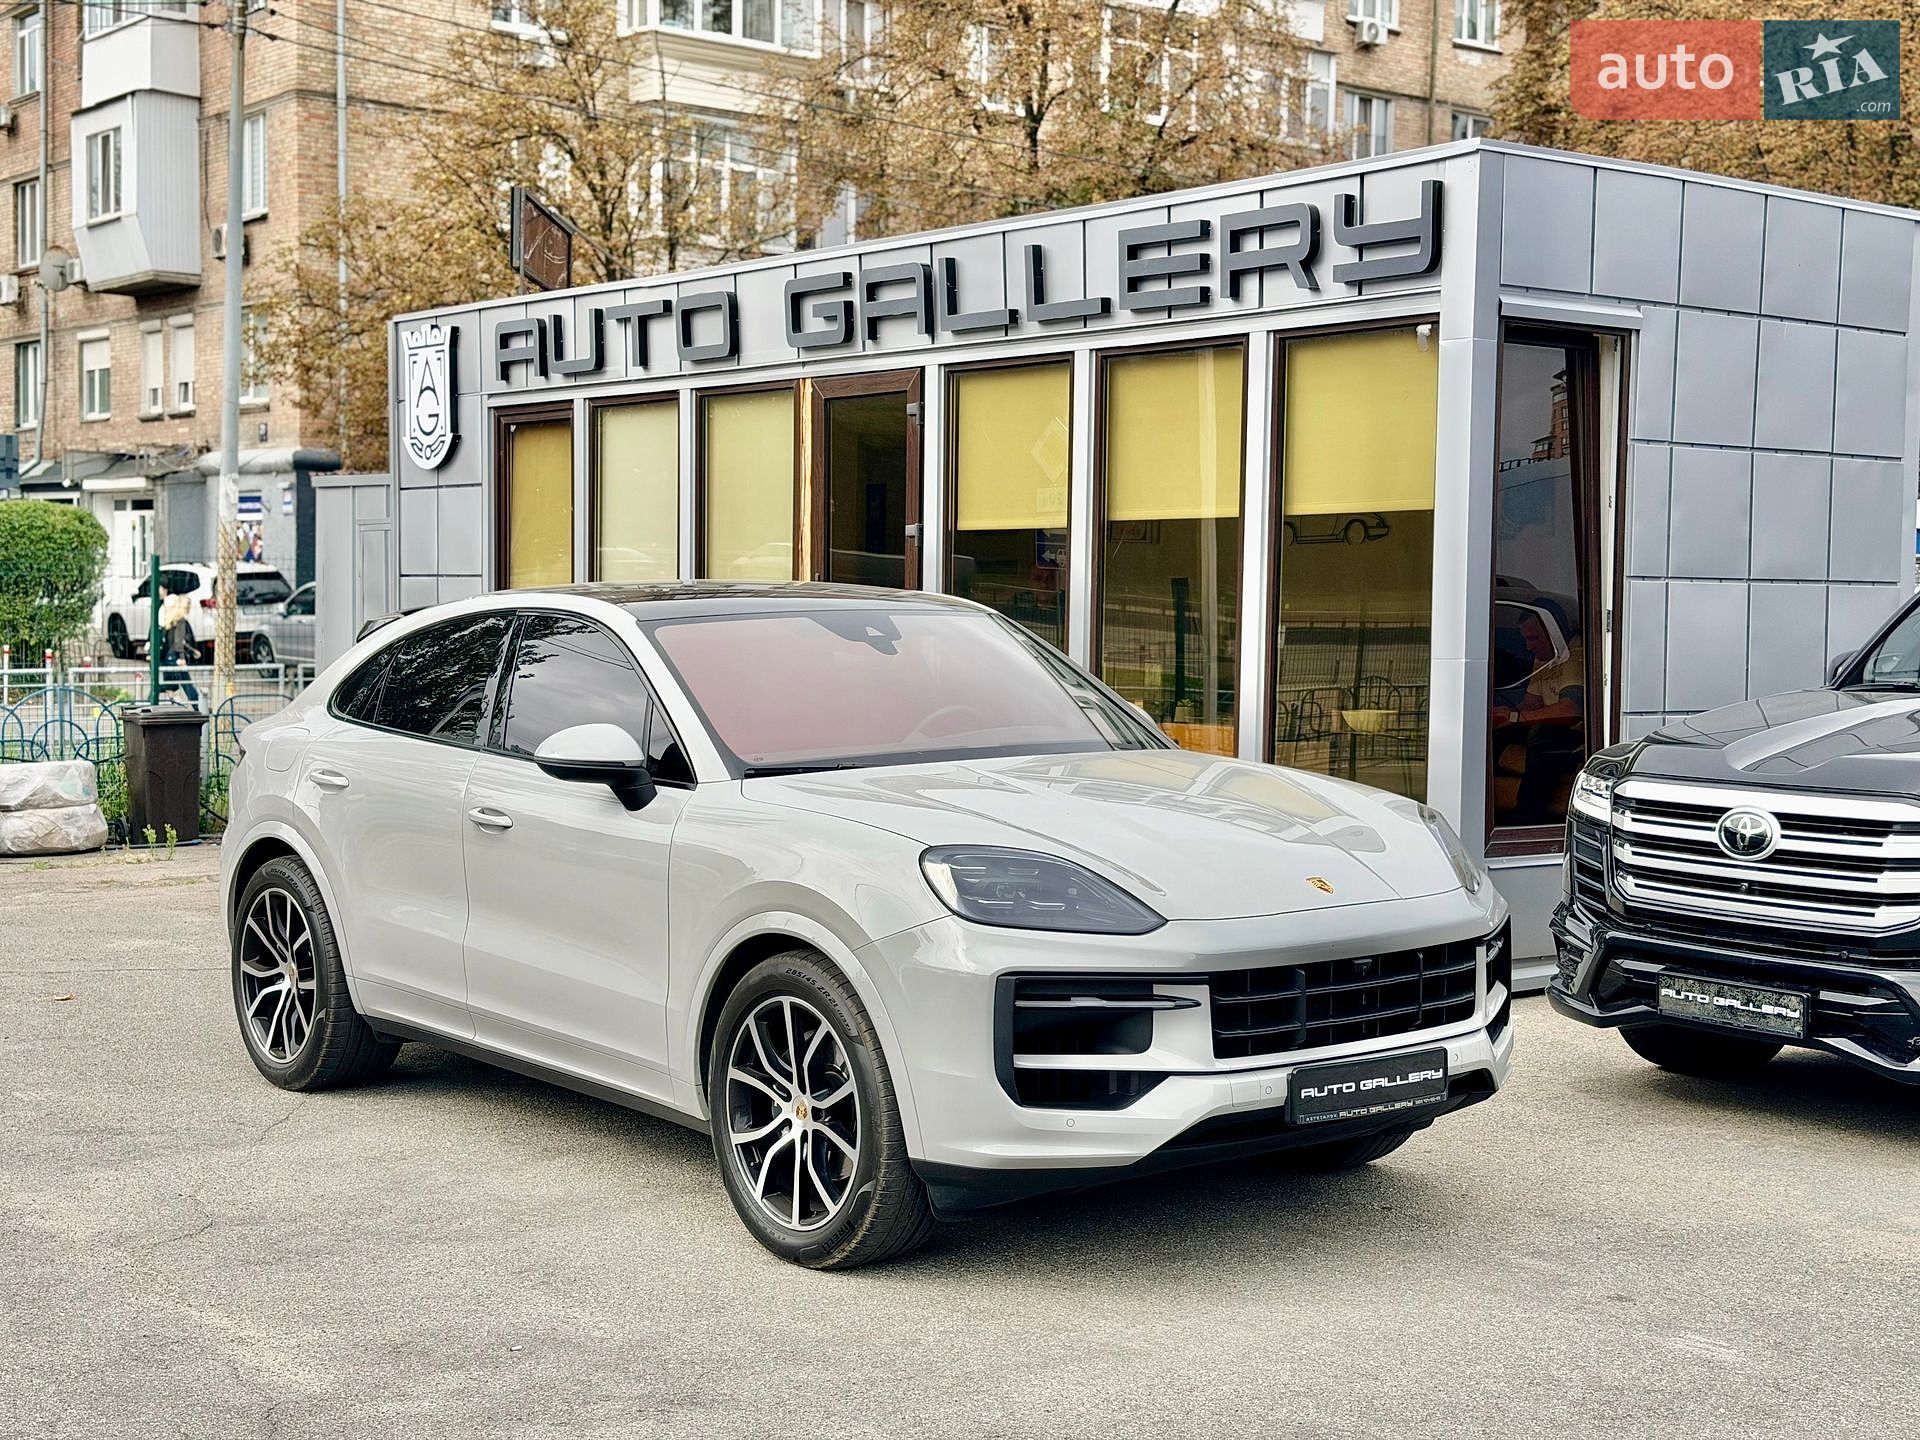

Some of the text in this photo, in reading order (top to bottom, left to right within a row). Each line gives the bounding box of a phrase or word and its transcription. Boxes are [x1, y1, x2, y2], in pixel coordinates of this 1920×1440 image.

[494, 179, 1444, 382] AUTO GALLERY
[1661, 988, 1800, 1018] AUTO GALLERY
[1301, 1068, 1443, 1099] AUTO GALLERY
[1339, 1107, 1367, 1119] AUTO
[1369, 1100, 1413, 1114] GALLERY
